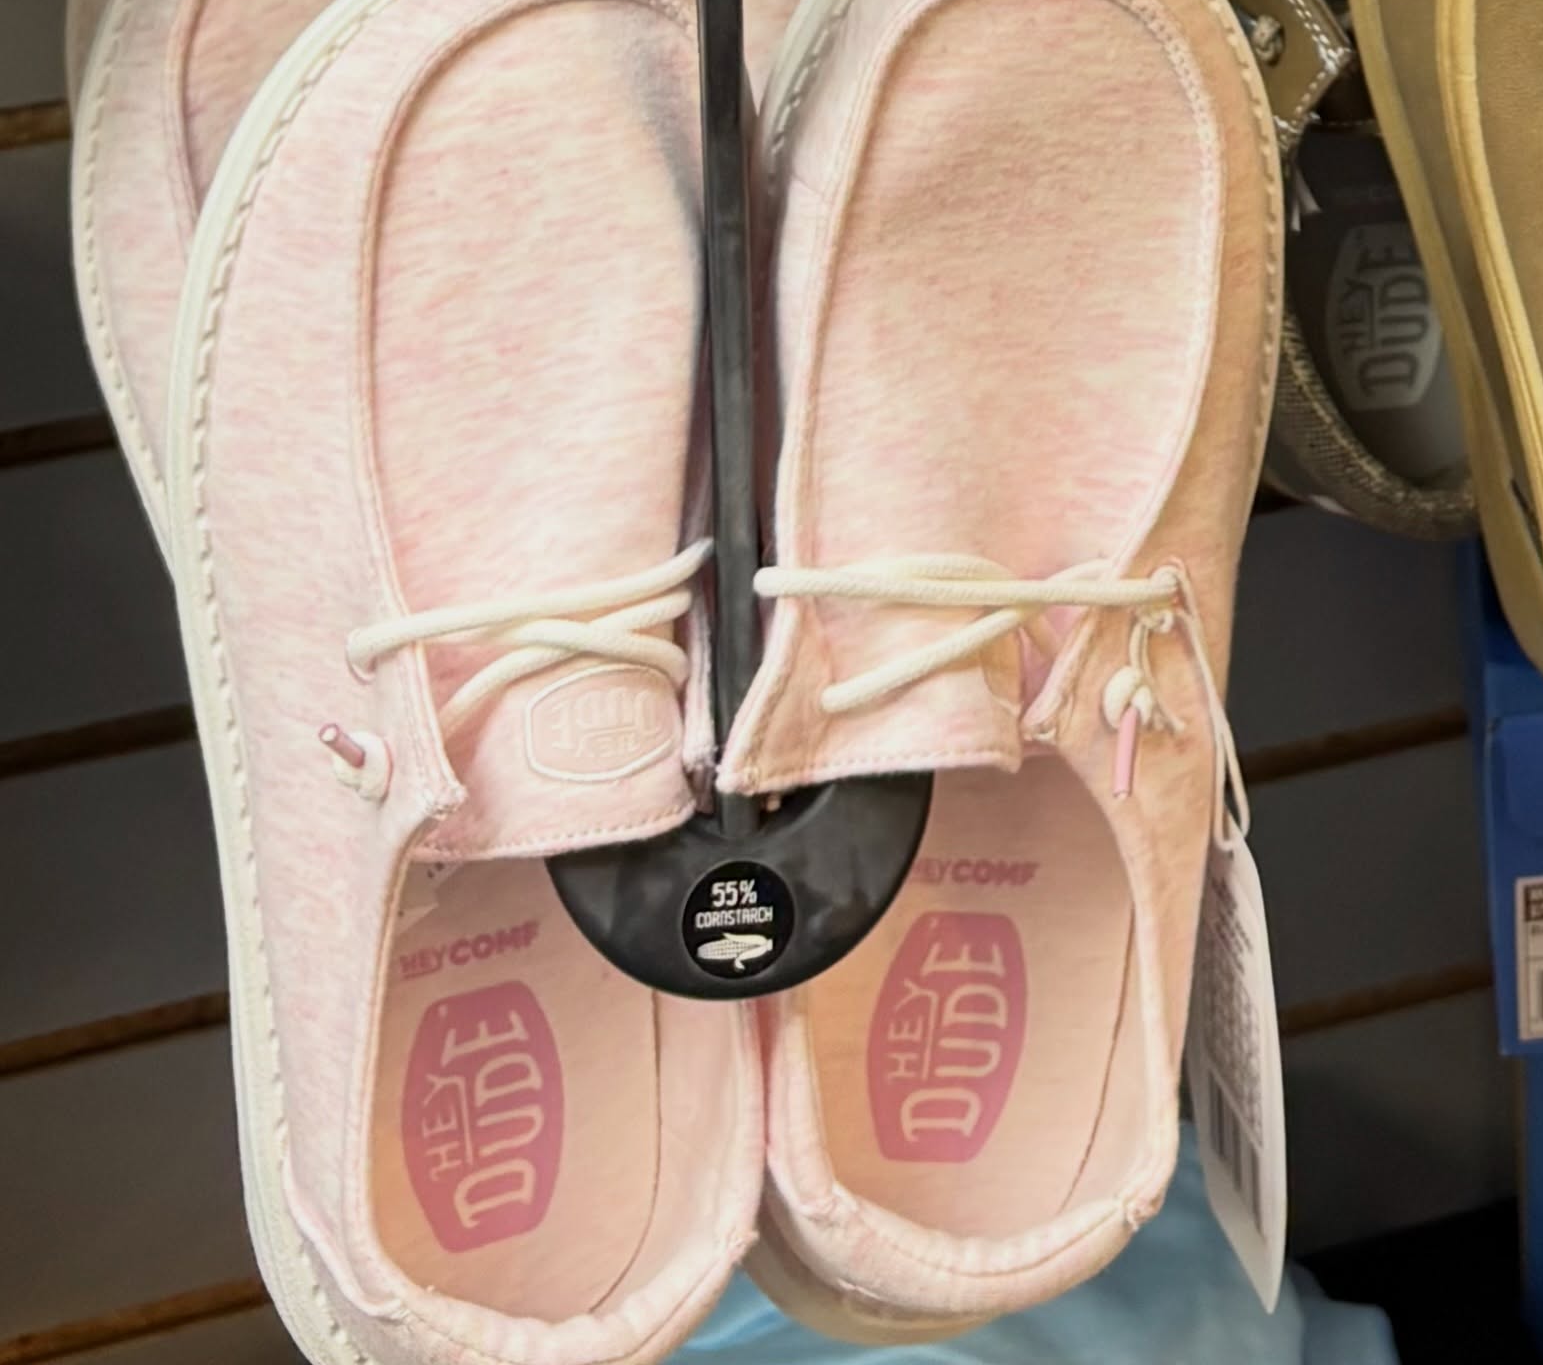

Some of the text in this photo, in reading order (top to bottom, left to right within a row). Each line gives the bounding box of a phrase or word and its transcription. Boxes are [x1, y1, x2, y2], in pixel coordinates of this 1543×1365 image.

[695, 906, 773, 929] CORNSTARCH
[711, 879, 758, 908] 55%
[887, 978, 939, 1086] HEY
[900, 942, 1009, 1143] DUDE
[421, 1072, 474, 1181] HEY
[441, 1010, 543, 1229] DUDE
